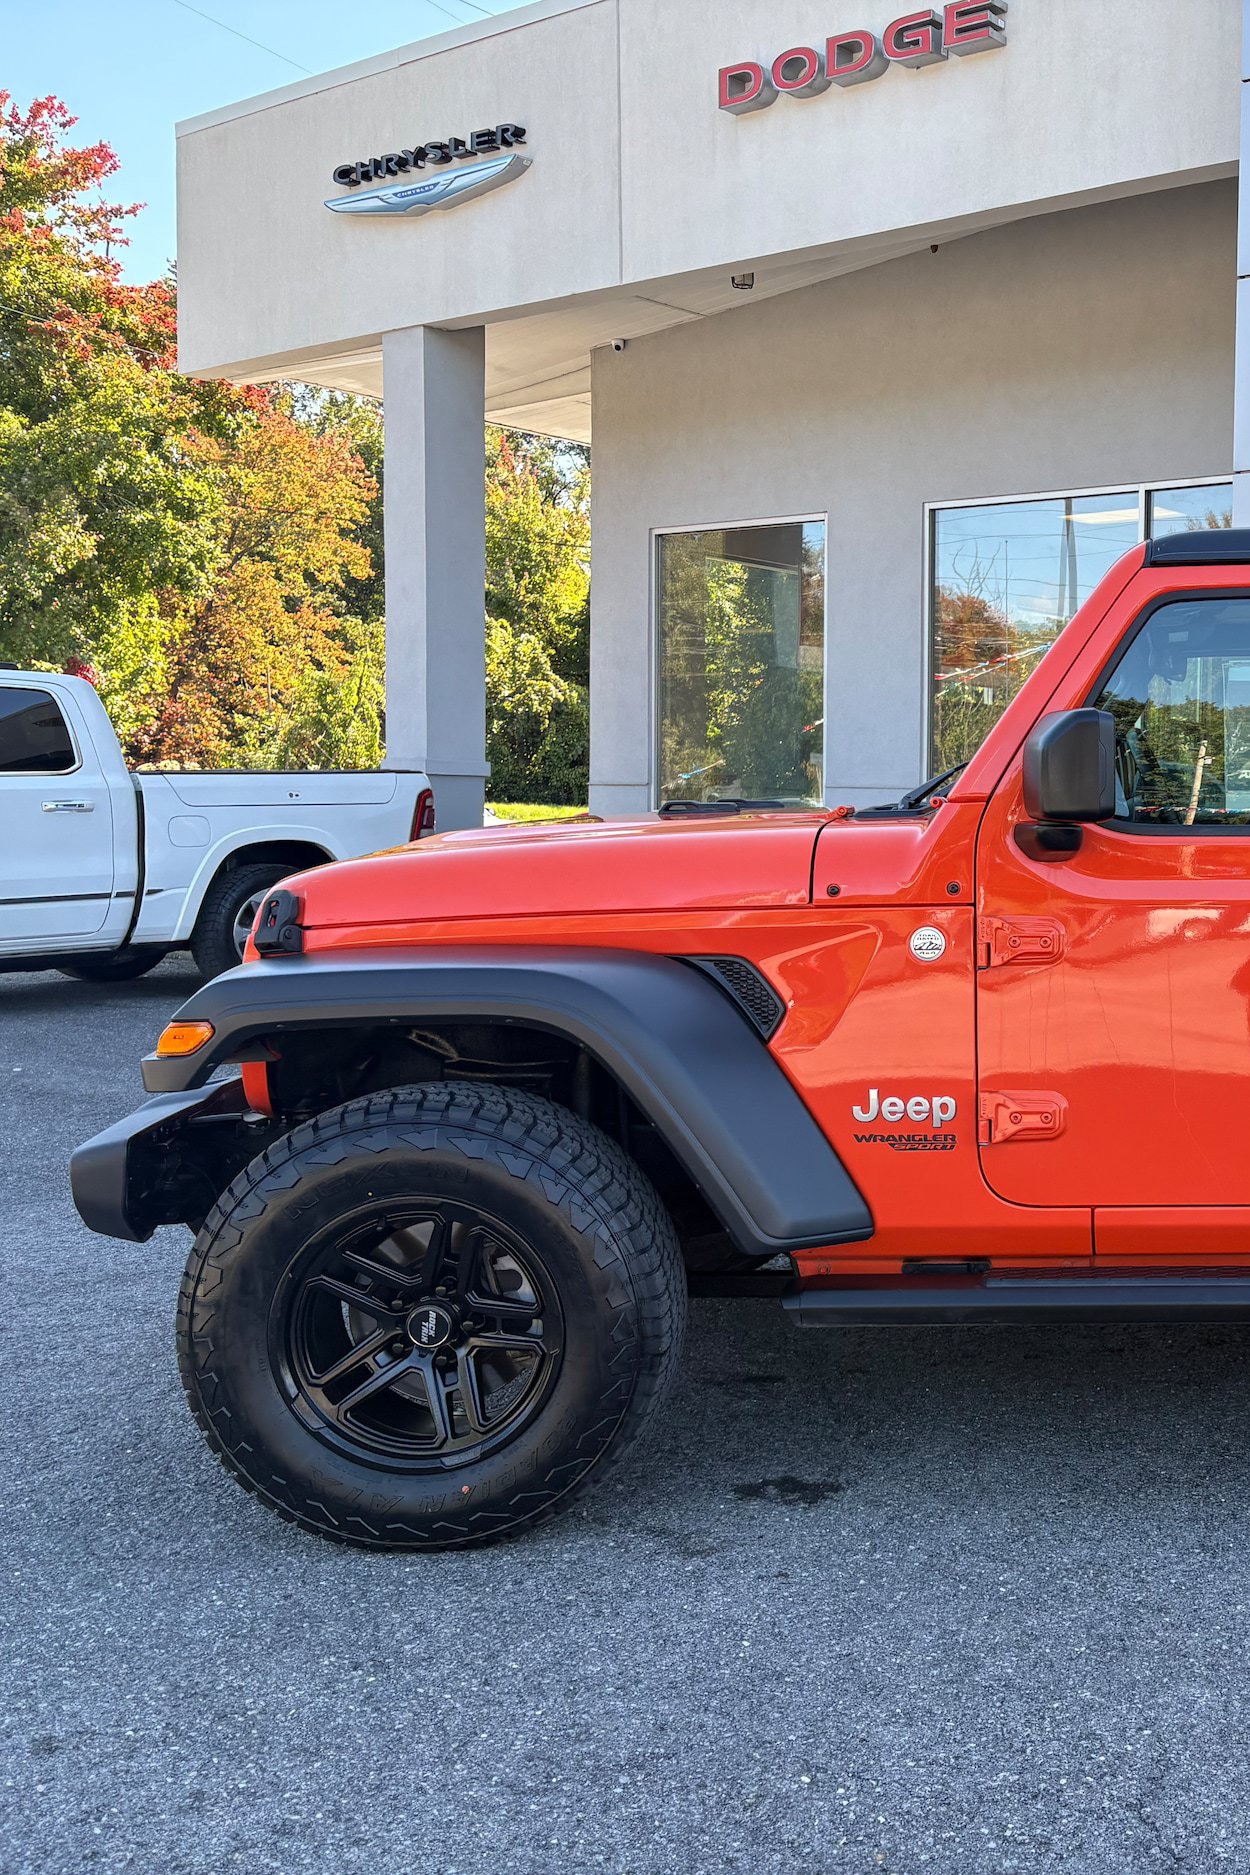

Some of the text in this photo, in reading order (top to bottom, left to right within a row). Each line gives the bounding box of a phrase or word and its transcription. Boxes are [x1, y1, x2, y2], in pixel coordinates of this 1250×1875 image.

[718, 0, 1004, 113] DODGE
[332, 123, 525, 187] CHRYSLER
[852, 1088, 957, 1128] Jeep
[853, 1133, 957, 1143] WRANGLER
[891, 1142, 956, 1150] SPORT
[428, 1310, 437, 1337] ROCK
